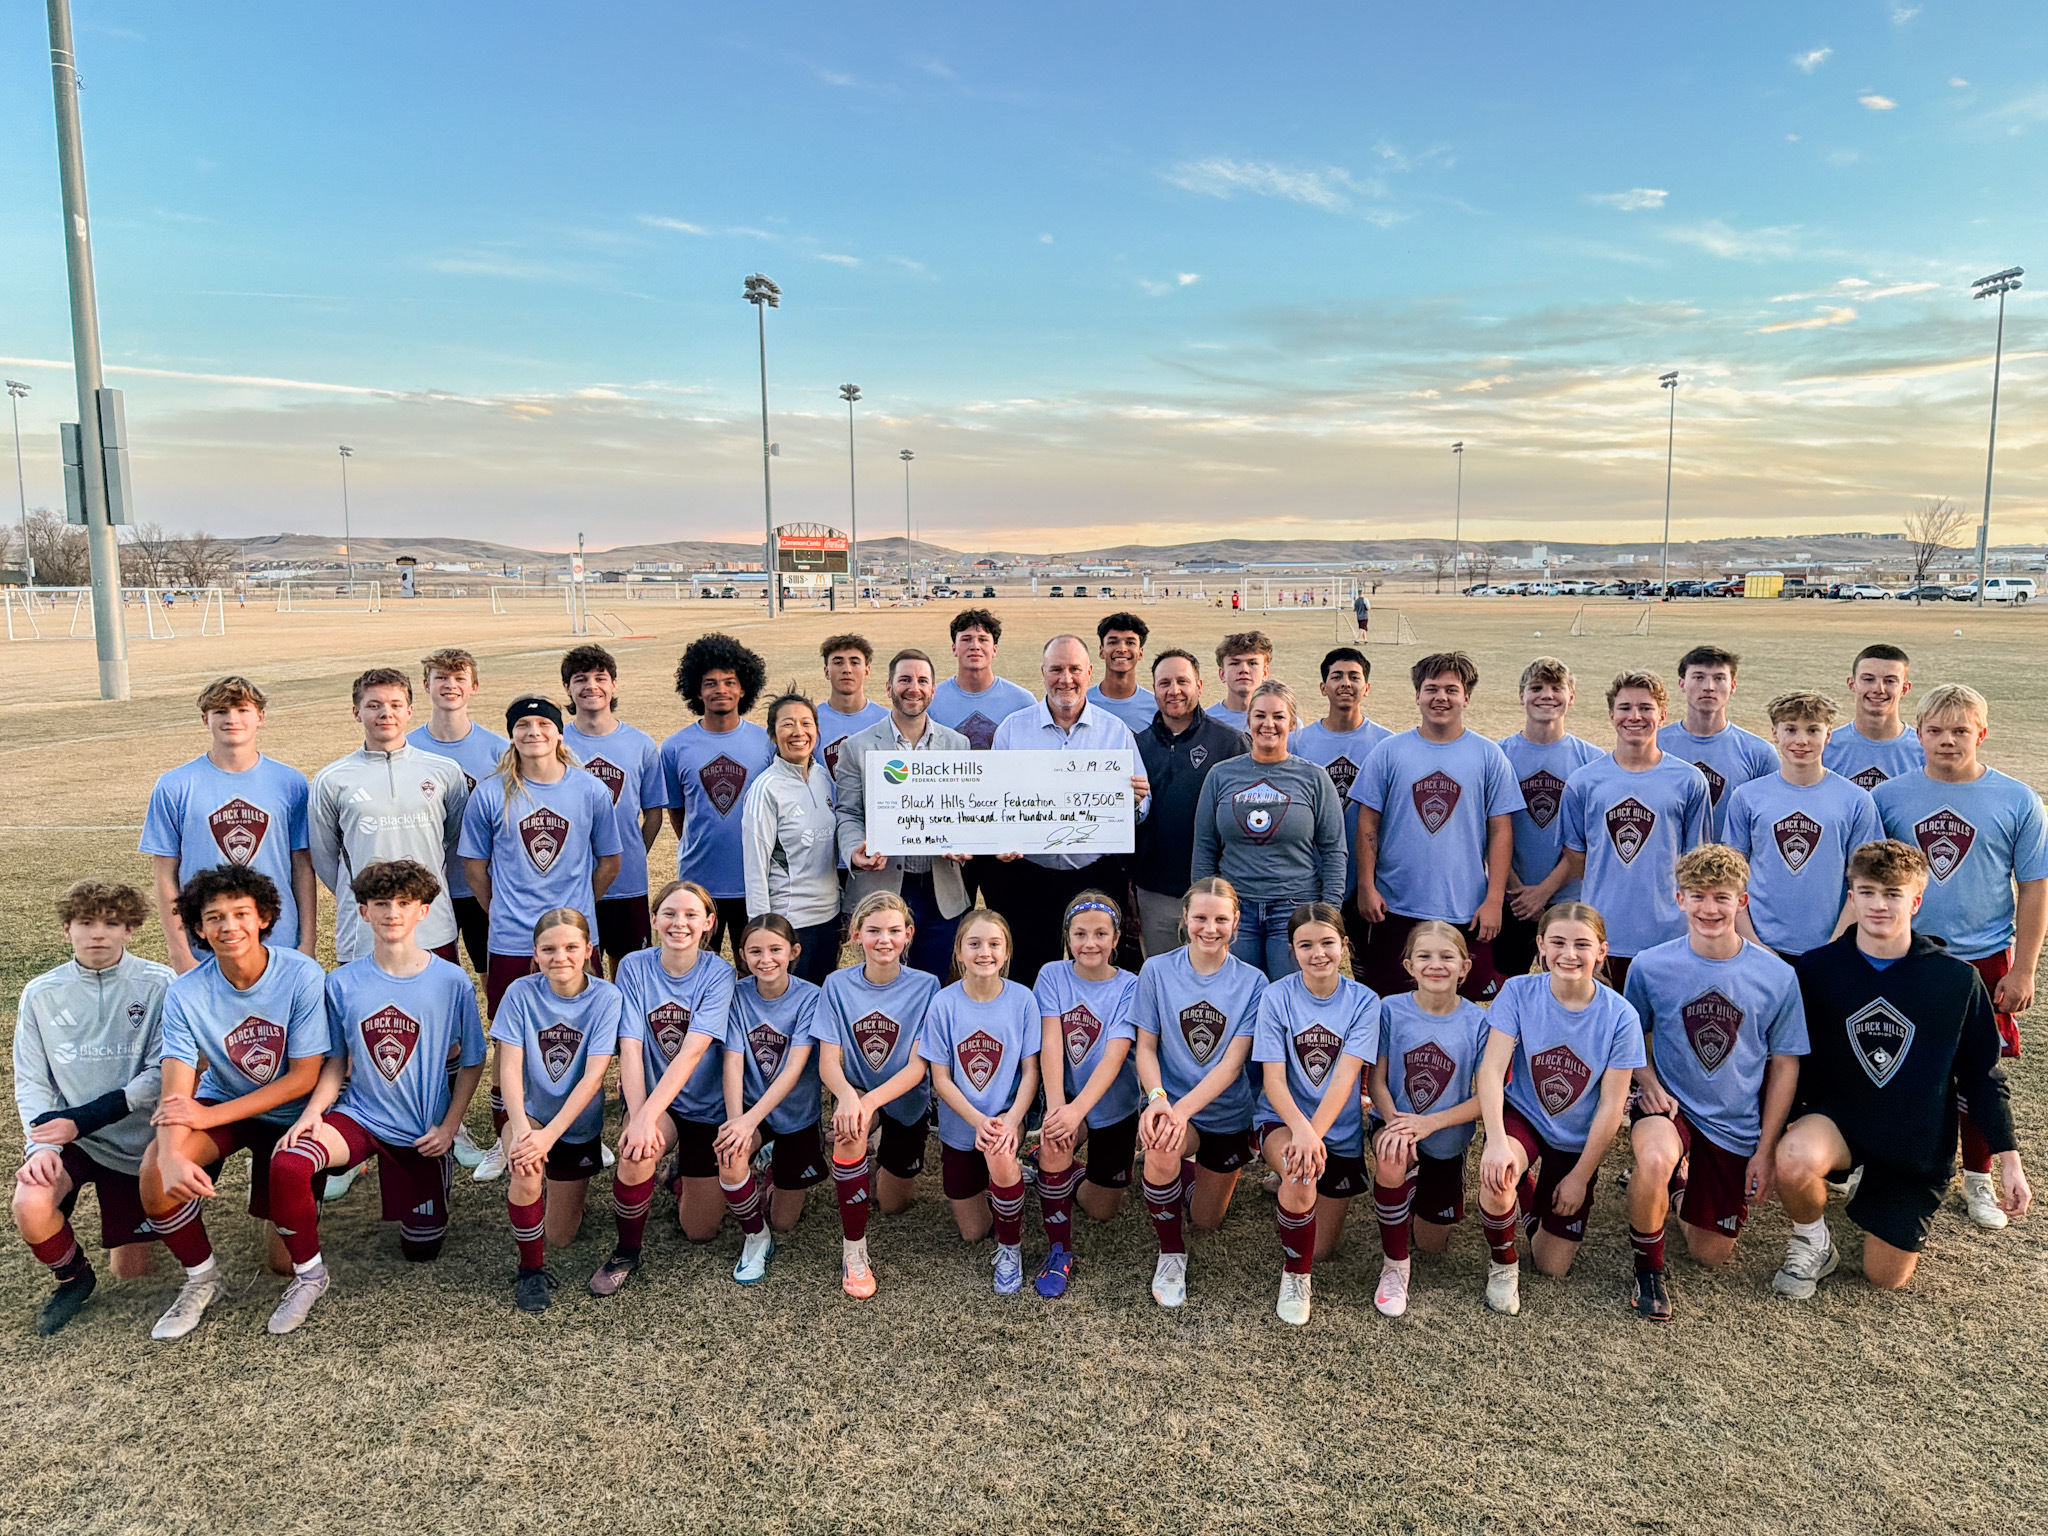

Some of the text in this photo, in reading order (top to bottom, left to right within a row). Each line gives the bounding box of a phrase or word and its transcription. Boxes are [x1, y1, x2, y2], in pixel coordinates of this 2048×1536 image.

[602, 766, 621, 780] HILLS
[703, 765, 743, 777] BLACK HILLS
[911, 762, 983, 775] Black Hills
[1416, 781, 1458, 793] BLACK HILLS
[1522, 779, 1543, 790] BLACK
[940, 793, 965, 809] Hills
[968, 792, 998, 809] Soccer
[1004, 791, 1056, 808] Federation
[213, 809, 265, 825] BLACK HILLS
[380, 814, 410, 827] Black
[897, 814, 925, 830] eighty
[929, 815, 955, 824] seven
[957, 811, 998, 824] thousand
[1001, 809, 1016, 822] five
[1020, 810, 1057, 823] hundred
[1060, 812, 1078, 822] and
[1609, 808, 1651, 822] BLACK HILLS
[523, 816, 565, 830] BLACK HILLS
[1776, 820, 1818, 833] BLACK HILLS
[1919, 820, 1970, 837] BLACK HILLS
[925, 834, 949, 844] Match
[651, 1010, 690, 1022] BLACK HILLS
[1182, 1009, 1223, 1024] BLACK HILLS
[1687, 1003, 1738, 1021] BLACK HILLS
[365, 1017, 416, 1033] BLACK HILLS
[855, 1020, 896, 1032] BLACK HILLS
[1063, 1012, 1098, 1029] BLACK HILLS
[228, 1026, 280, 1046] BLACK HILLS
[540, 1031, 581, 1042] BLACK HILLS
[1856, 1022, 1904, 1038] BLACK HILLS
[767, 1034, 784, 1044] HILLS
[1297, 1033, 1339, 1047] BLACK HILLS
[80, 1044, 114, 1056] Black
[960, 1040, 1000, 1053] BLACK HILLS
[1406, 1052, 1452, 1072] BLACK HILLS
[1535, 1054, 1587, 1077] BLACK HILLS
